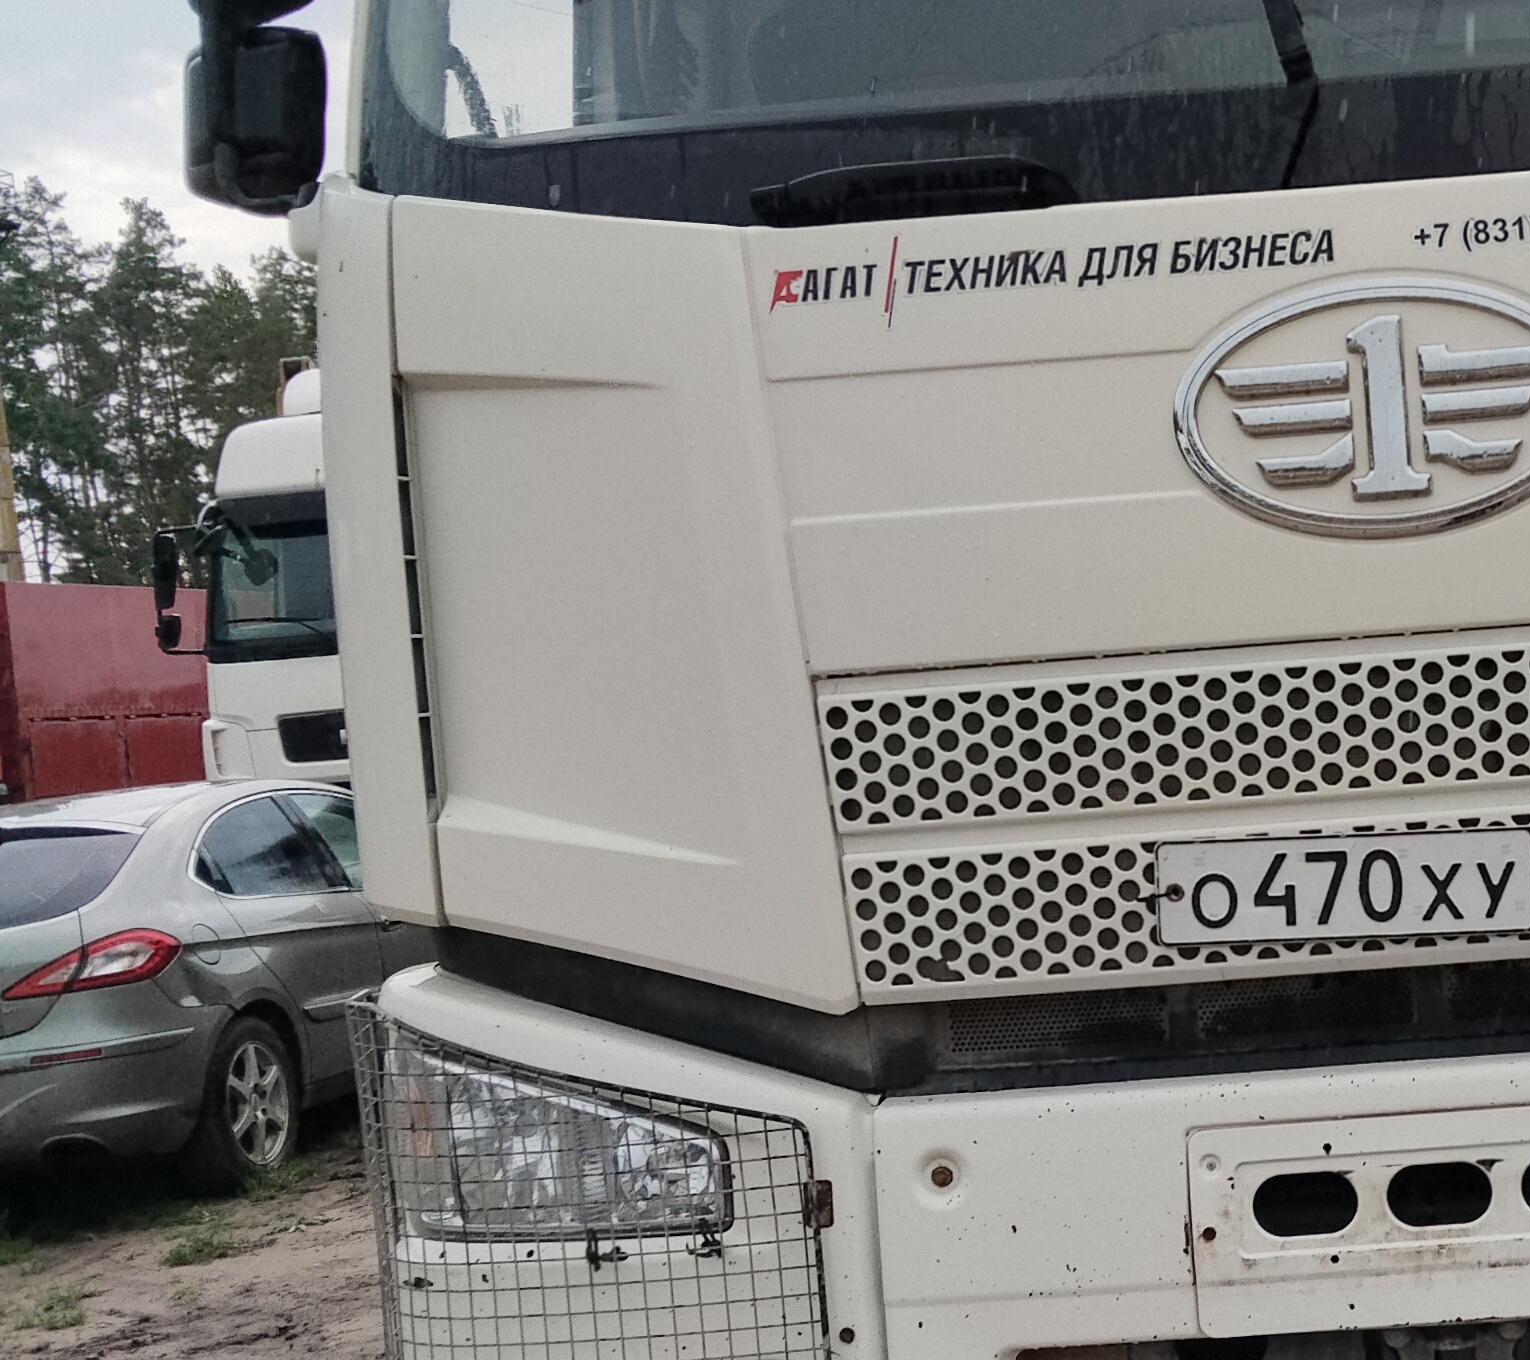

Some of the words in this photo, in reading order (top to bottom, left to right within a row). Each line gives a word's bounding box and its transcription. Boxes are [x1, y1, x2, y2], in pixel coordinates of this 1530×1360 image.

[1413, 222, 1450, 248] +7
[801, 263, 878, 302] АГАТ
[904, 248, 1068, 296] ТЕХНИКА
[1078, 241, 1160, 288] ДЛЯ
[1169, 228, 1336, 276] БИЗНЕСА
